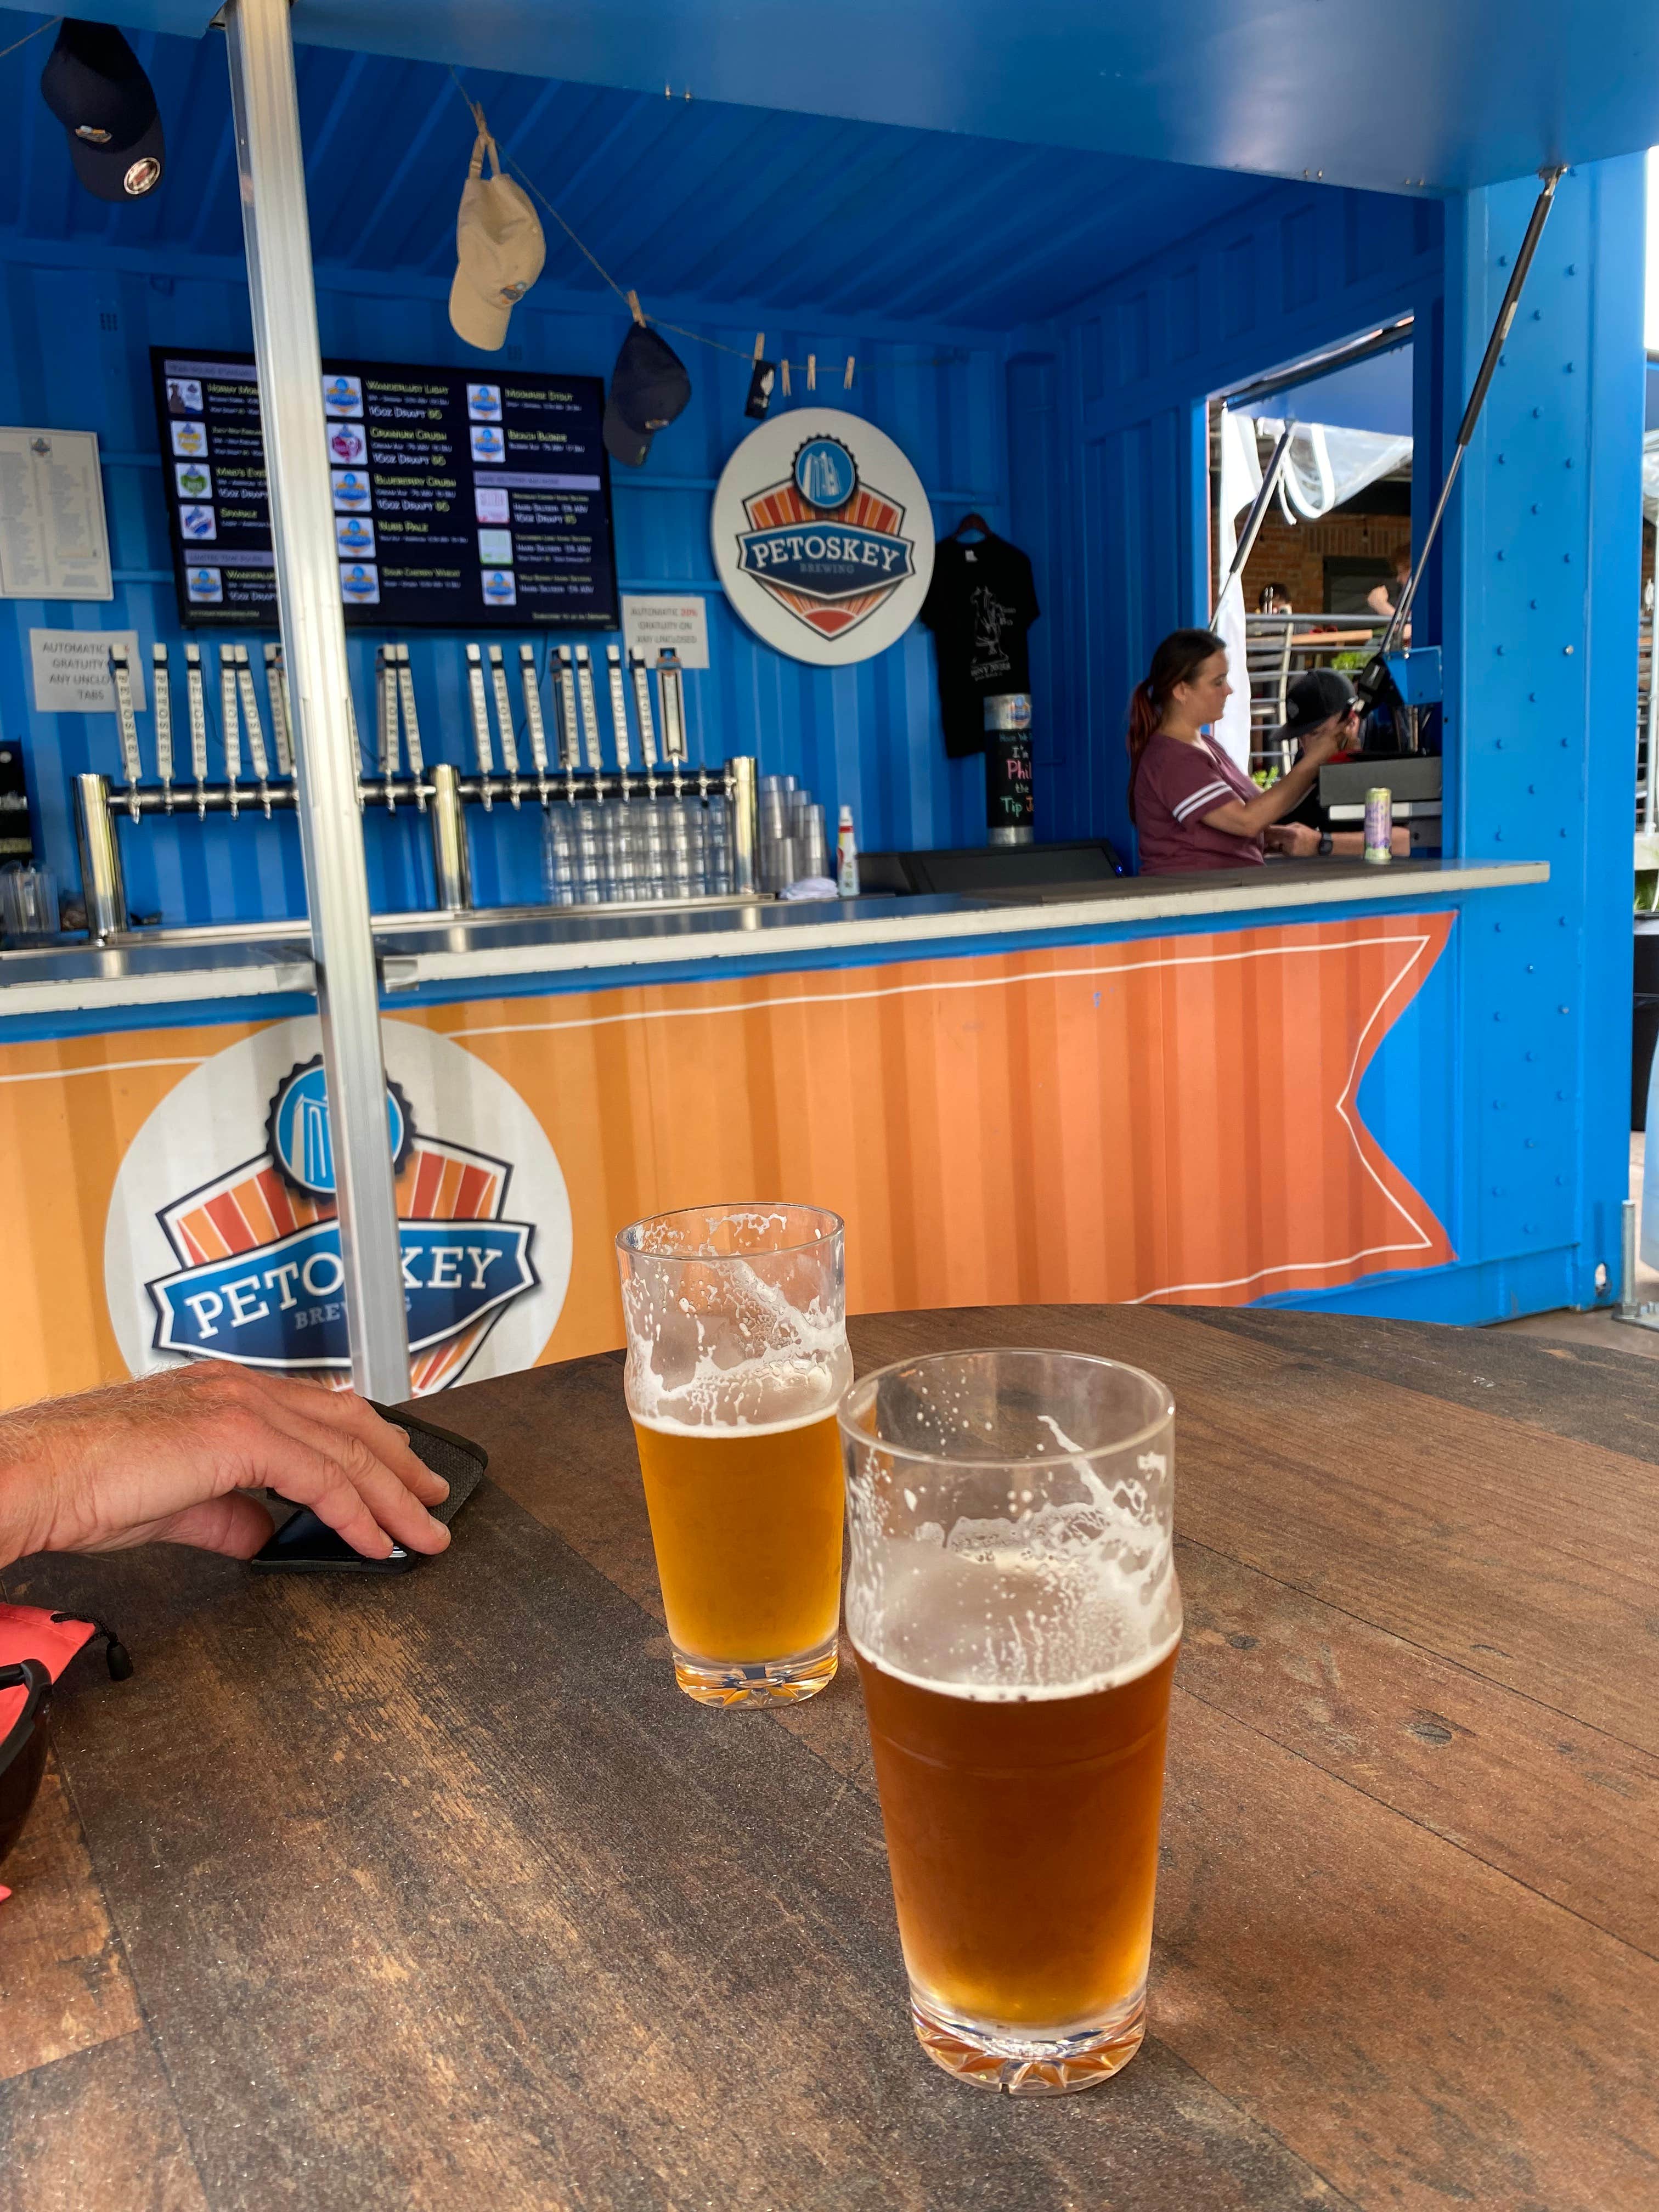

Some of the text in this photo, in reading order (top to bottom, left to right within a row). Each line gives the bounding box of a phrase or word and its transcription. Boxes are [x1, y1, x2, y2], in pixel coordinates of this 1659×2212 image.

[752, 535, 900, 572] PETOSKEY
[800, 562, 855, 575] BREWING
[43, 641, 106, 654] AUTOMATIC
[53, 658, 104, 670] GRATUITY
[49, 674, 71, 685] ANY
[77, 689, 105, 701] TABS
[1006, 759, 1032, 780] Phil
[1015, 782, 1030, 793] the
[1000, 796, 1023, 817] Tip
[184, 1246, 503, 1340] PETOKEY
